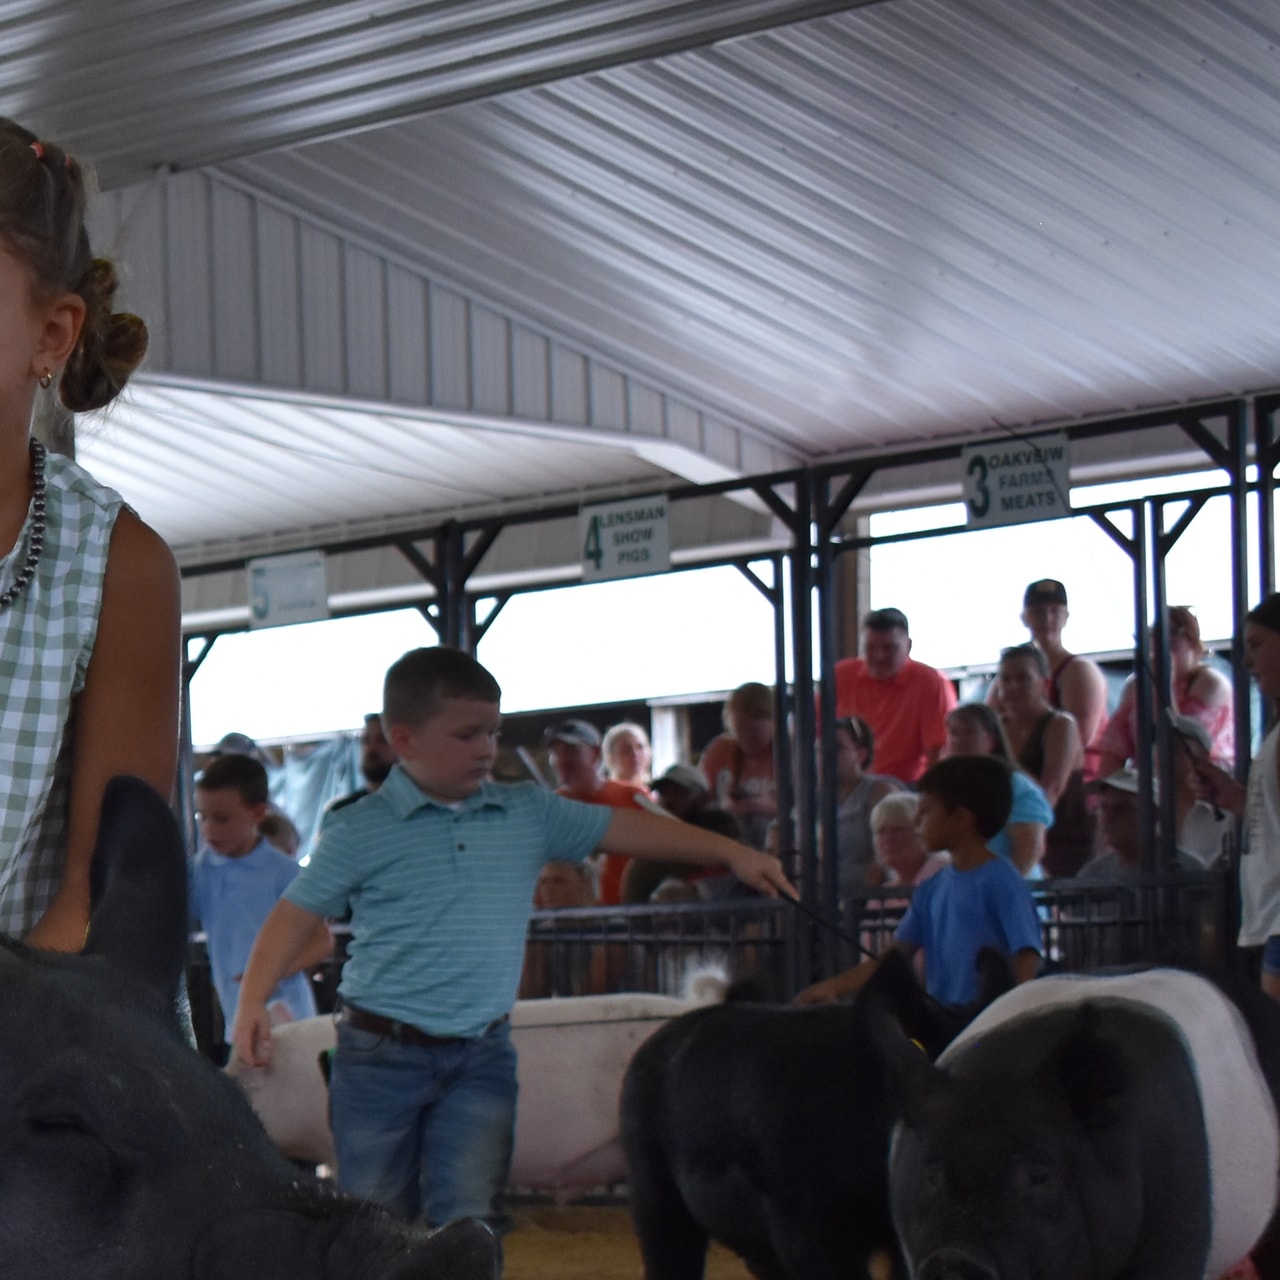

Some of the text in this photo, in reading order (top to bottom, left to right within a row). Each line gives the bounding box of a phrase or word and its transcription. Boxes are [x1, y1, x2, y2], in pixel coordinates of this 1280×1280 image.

[967, 455, 990, 518] 3
[999, 470, 1054, 490] FARMS
[1000, 491, 1055, 511] MEATS
[584, 506, 665, 570] 4 LENSMAN
[612, 527, 653, 545] SHOW
[617, 548, 650, 565] PIGS
[252, 568, 269, 620] 5
